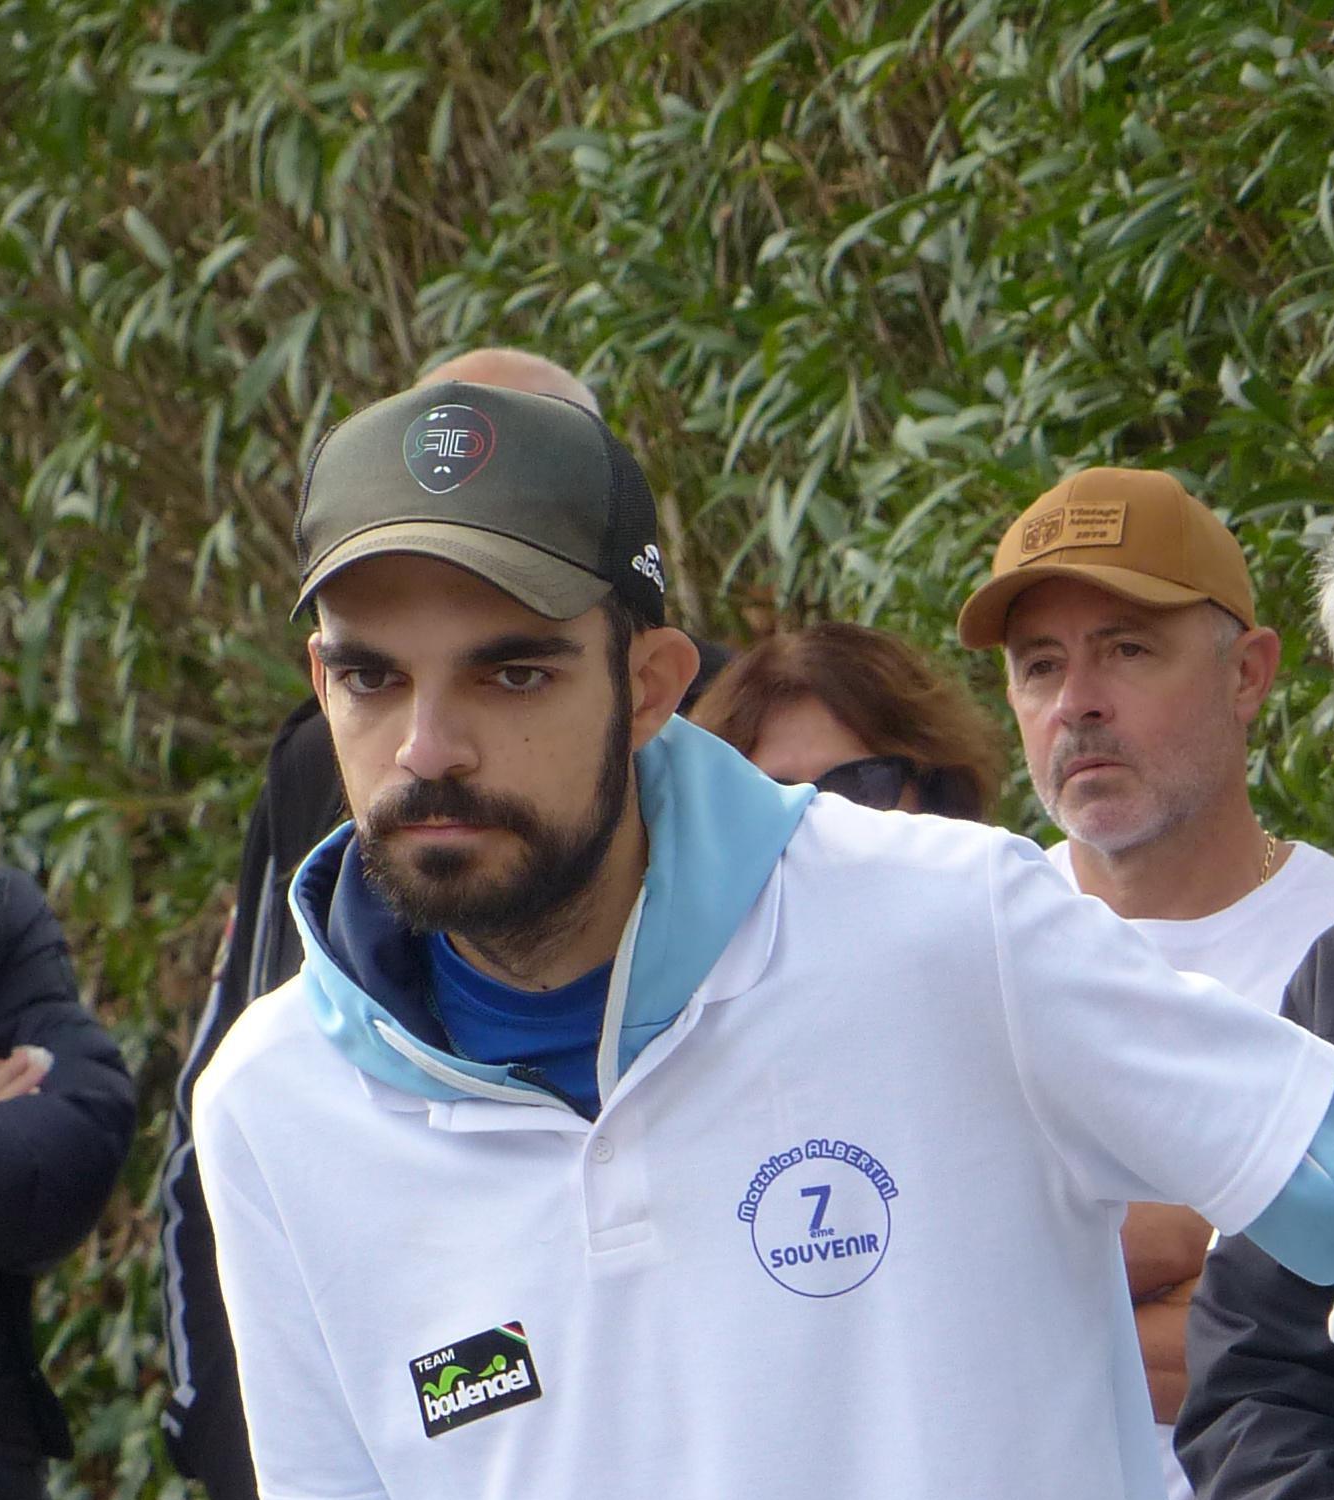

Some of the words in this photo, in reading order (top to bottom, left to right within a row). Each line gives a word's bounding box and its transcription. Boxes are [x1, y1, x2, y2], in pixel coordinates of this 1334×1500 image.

[805, 1138, 899, 1201] ALBERTINI
[800, 1184, 831, 1231] 7
[770, 1233, 879, 1269] SOUVENIR
[415, 1348, 456, 1373] TEAM
